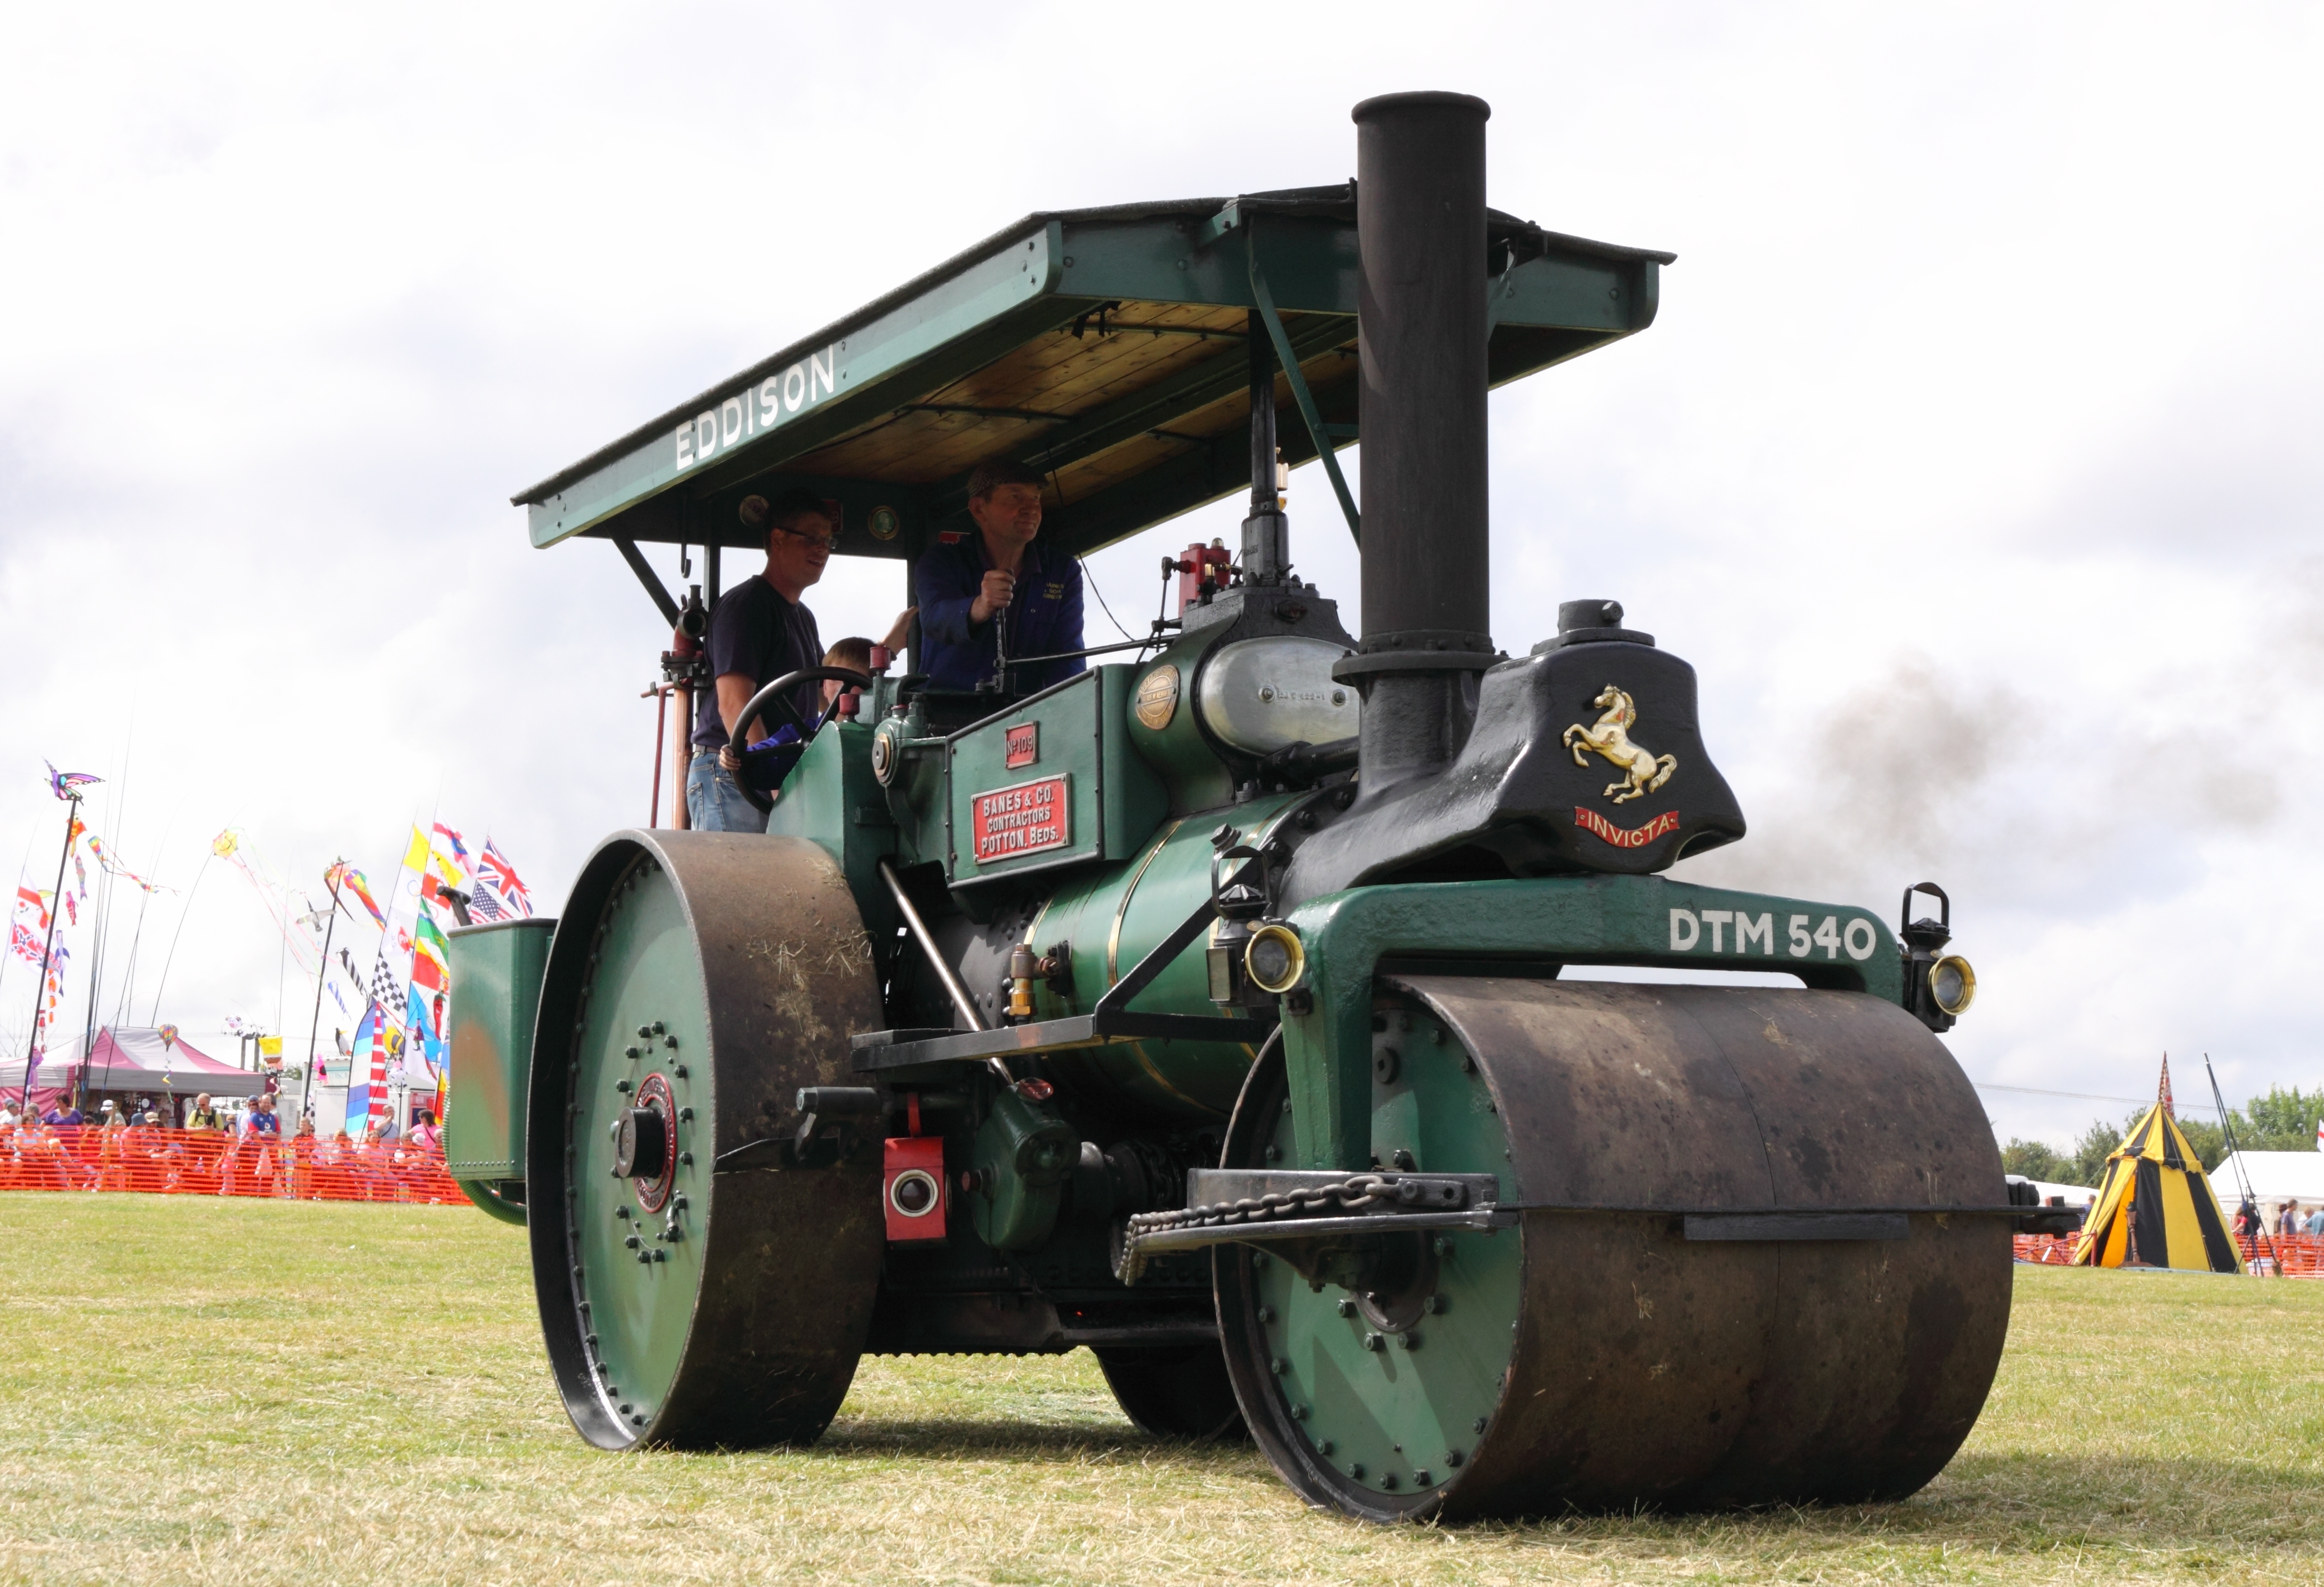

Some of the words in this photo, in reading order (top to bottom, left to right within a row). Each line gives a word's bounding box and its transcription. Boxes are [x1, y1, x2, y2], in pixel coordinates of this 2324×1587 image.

[676, 344, 834, 470] EDDISON
[1018, 735, 1033, 753] 109
[983, 792, 1021, 817] BANES
[1025, 792, 1032, 807] &
[1036, 785, 1054, 804] CO.
[987, 806, 1051, 833] CONTRACTORS
[1588, 811, 1670, 847] INVICTA
[982, 829, 1028, 855] POTTON,
[1670, 908, 1773, 955] DTM
[1789, 915, 1877, 961] 540
